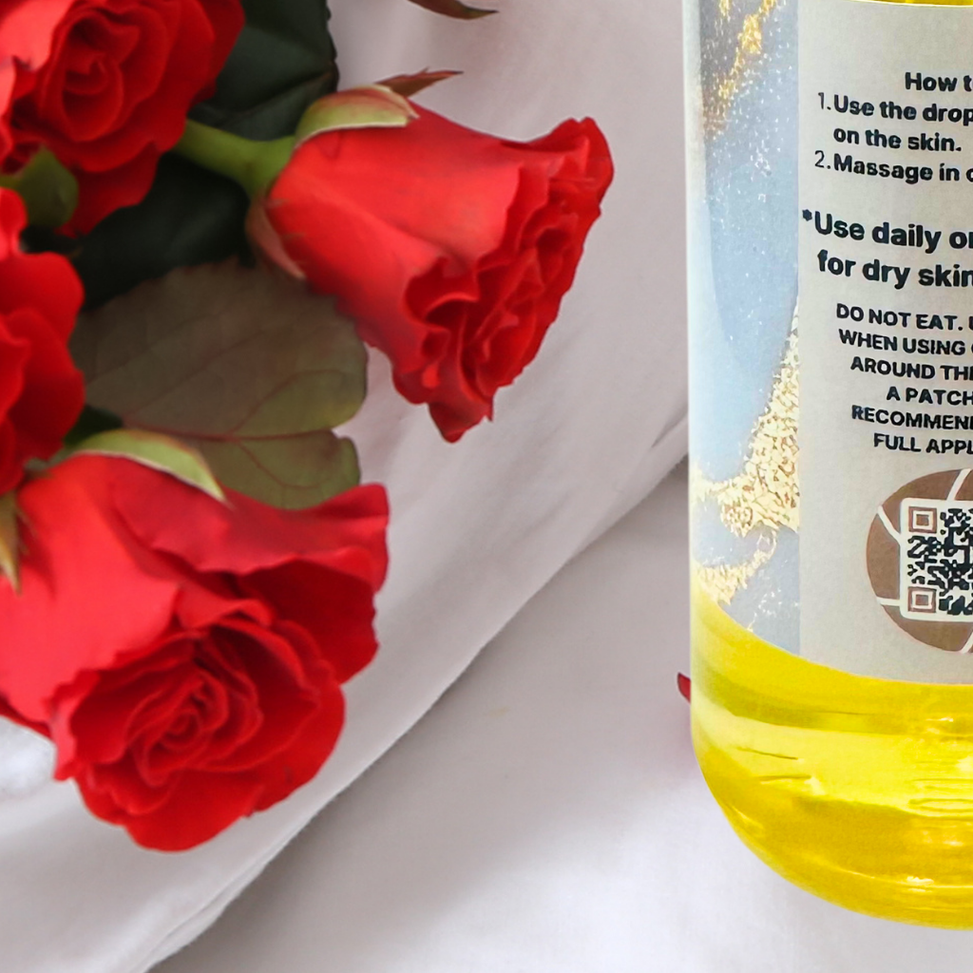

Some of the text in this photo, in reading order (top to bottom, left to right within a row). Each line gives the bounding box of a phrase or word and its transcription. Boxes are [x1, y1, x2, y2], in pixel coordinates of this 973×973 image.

[904, 71, 958, 93] How
[878, 100, 918, 121] the
[832, 127, 962, 153] on the skin.
[938, 162, 961, 182] in
[871, 221, 942, 255] daily
[816, 248, 857, 278] for
[861, 258, 912, 291] dry
[835, 302, 865, 323] DO
[868, 308, 912, 328] NOT
[915, 313, 964, 332] EAT.
[838, 328, 898, 352] WHEN
[902, 337, 966, 356] USING
[849, 355, 936, 380] AROUND
[885, 385, 901, 402] A
[873, 432, 922, 453] FULL
